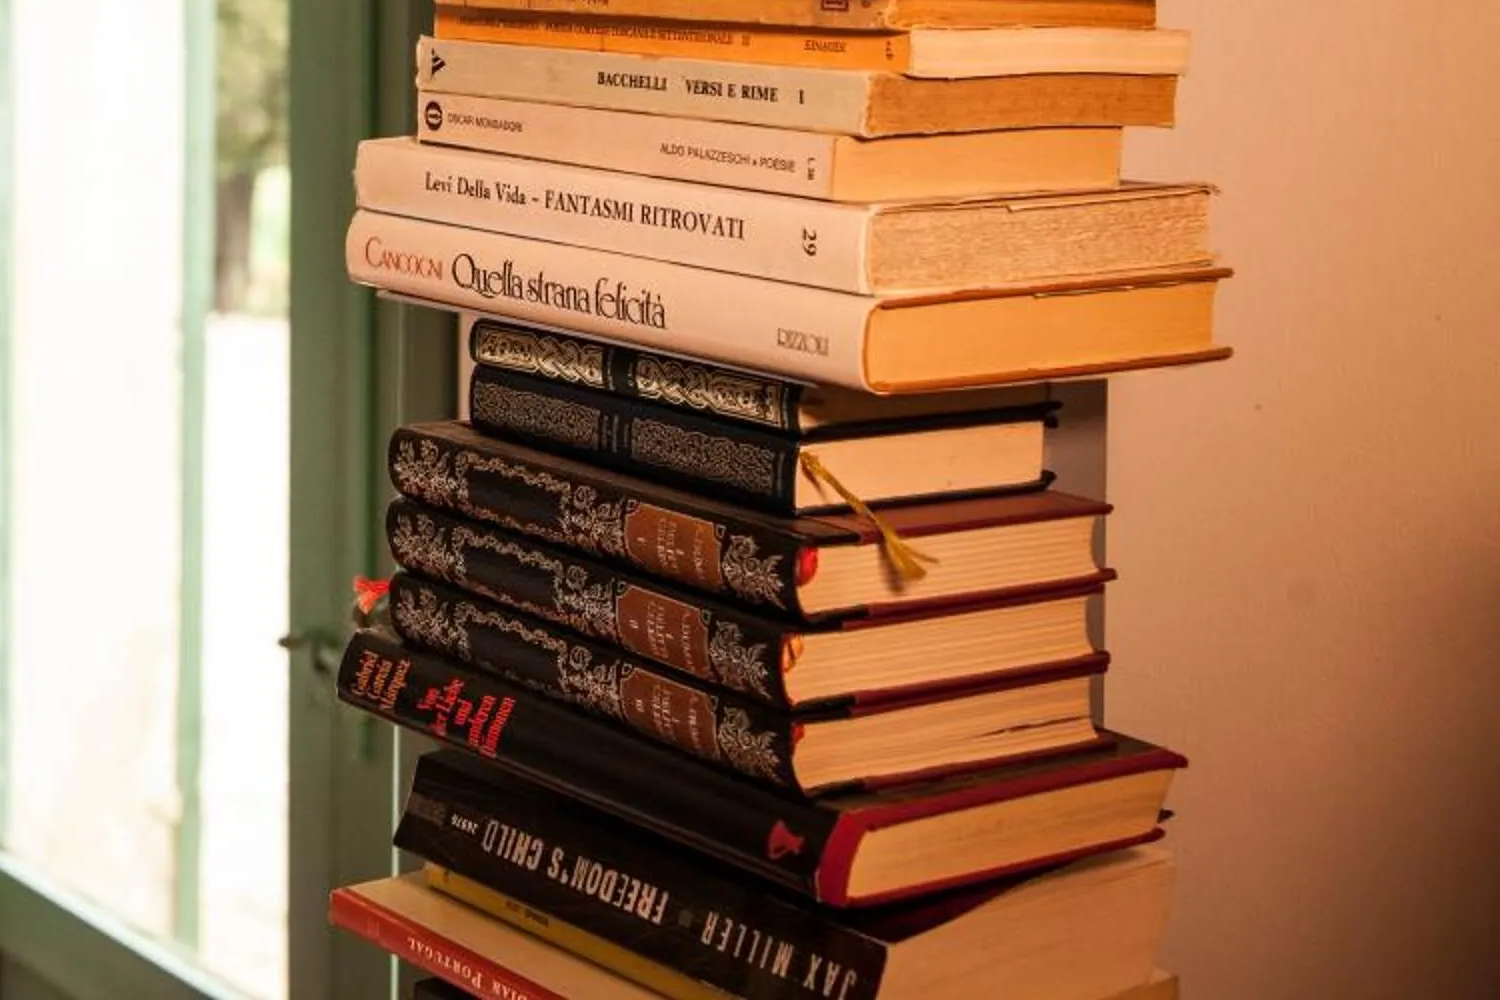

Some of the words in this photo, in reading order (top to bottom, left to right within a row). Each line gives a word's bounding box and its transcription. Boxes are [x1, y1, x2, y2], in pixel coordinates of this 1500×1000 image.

[596, 71, 668, 91] BACCHELLI
[685, 79, 724, 97] VERSI
[727, 83, 737, 98] E
[741, 84, 779, 103] RIME
[447, 112, 474, 126] OSCAR
[475, 116, 524, 133] MONDADORI
[660, 141, 686, 157] ALDO
[687, 146, 751, 166] PALAZZESCHI
[759, 155, 797, 174] POESIE
[425, 171, 453, 193] Levi
[457, 176, 492, 199] Della
[495, 182, 527, 205] Vida
[544, 188, 634, 223] FANTASMI
[640, 203, 746, 242] RITROVATI
[802, 227, 818, 258] 29
[451, 252, 524, 303] Quella
[527, 270, 592, 315] strana
[595, 276, 668, 330] felicità
[776, 327, 830, 357] RIZZOLI
[479, 817, 543, 873] CHILD
[546, 843, 672, 926] FREEDOM'S
[406, 936, 484, 990] PORTUGAL
[699, 909, 792, 977] MILLER
[801, 954, 859, 996] JAX
